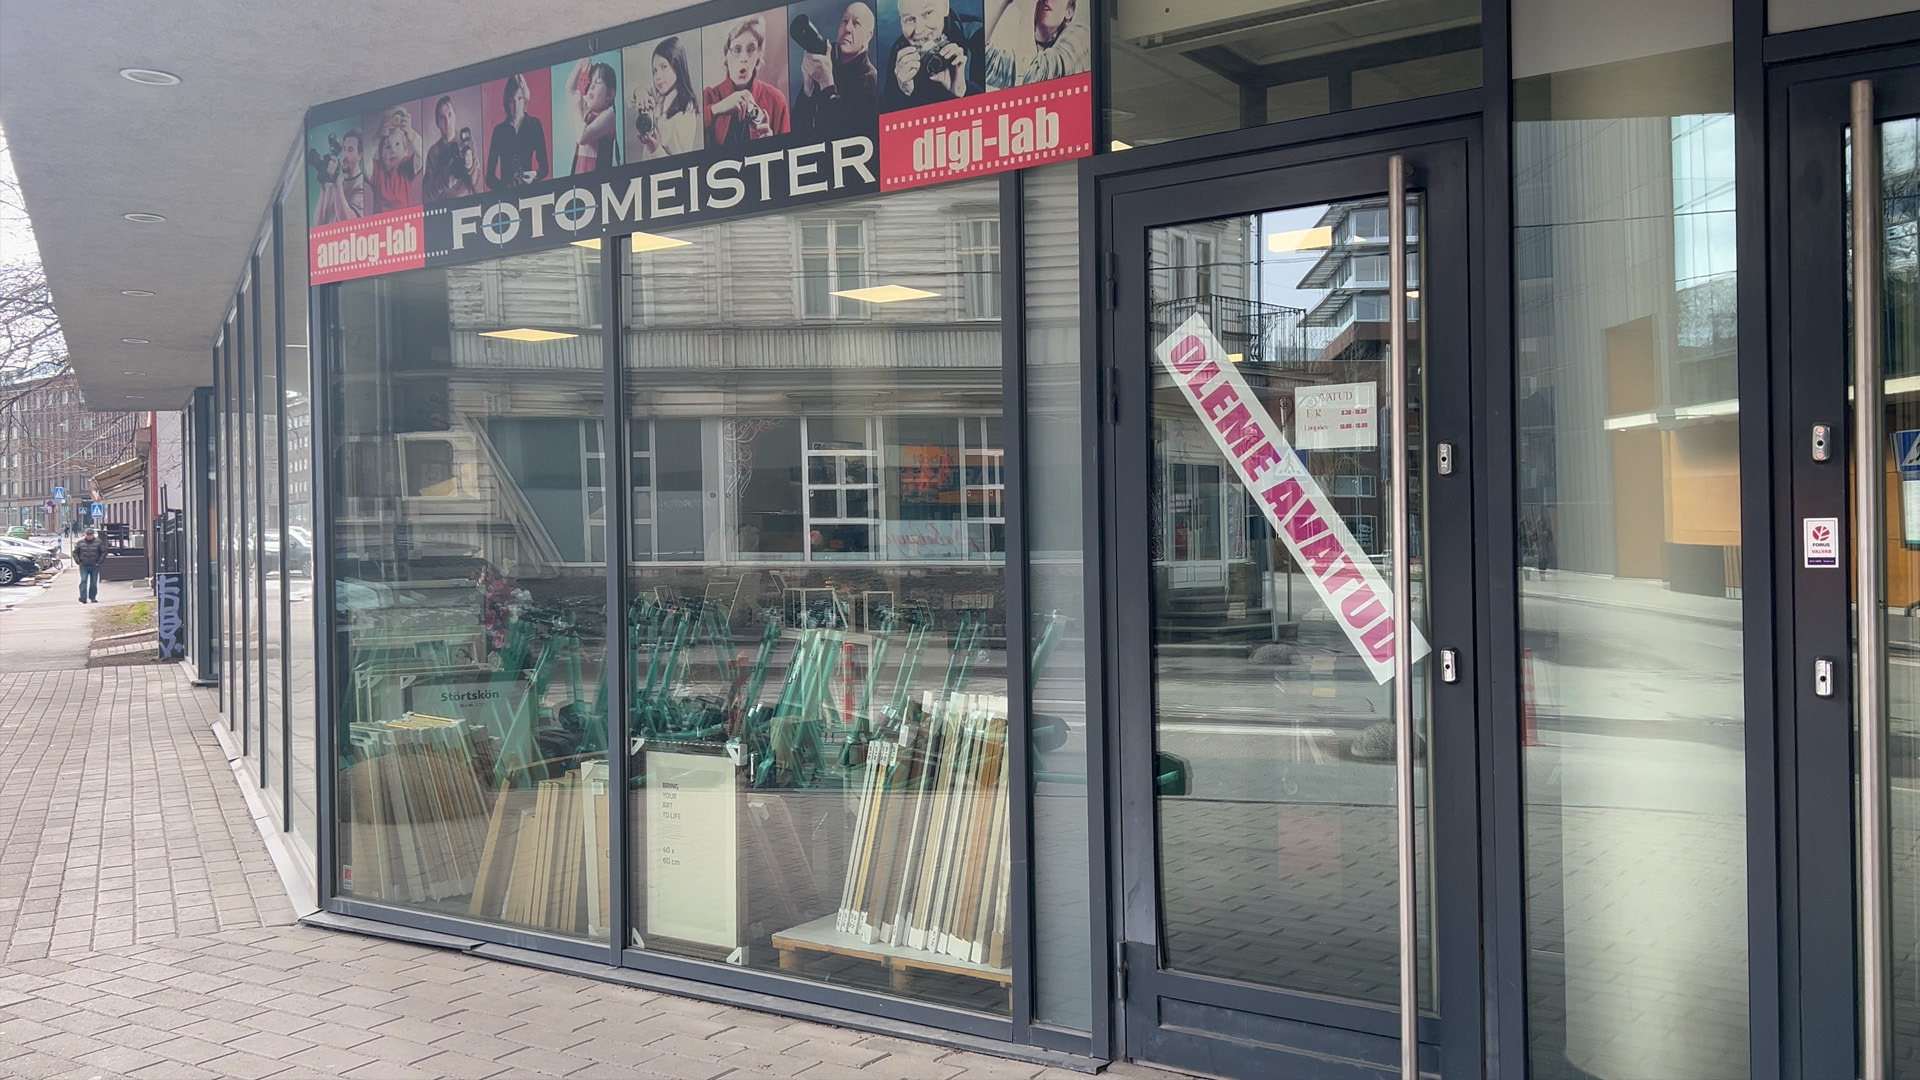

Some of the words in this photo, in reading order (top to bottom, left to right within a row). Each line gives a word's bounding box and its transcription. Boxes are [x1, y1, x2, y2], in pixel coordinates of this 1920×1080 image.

[913, 107, 1060, 172] digi-lab
[451, 136, 877, 250] FOTOMEISTER
[317, 222, 418, 269] analog-lab
[1316, 391, 1353, 402] VATUD
[1170, 334, 1282, 483] OLEME
[1261, 477, 1396, 664] AVATUD
[440, 689, 500, 702] Störtskön
[662, 792, 677, 800] YOUR
[662, 801, 673, 809] ART
[662, 811, 670, 819] TO
[670, 812, 682, 820] LIFE
